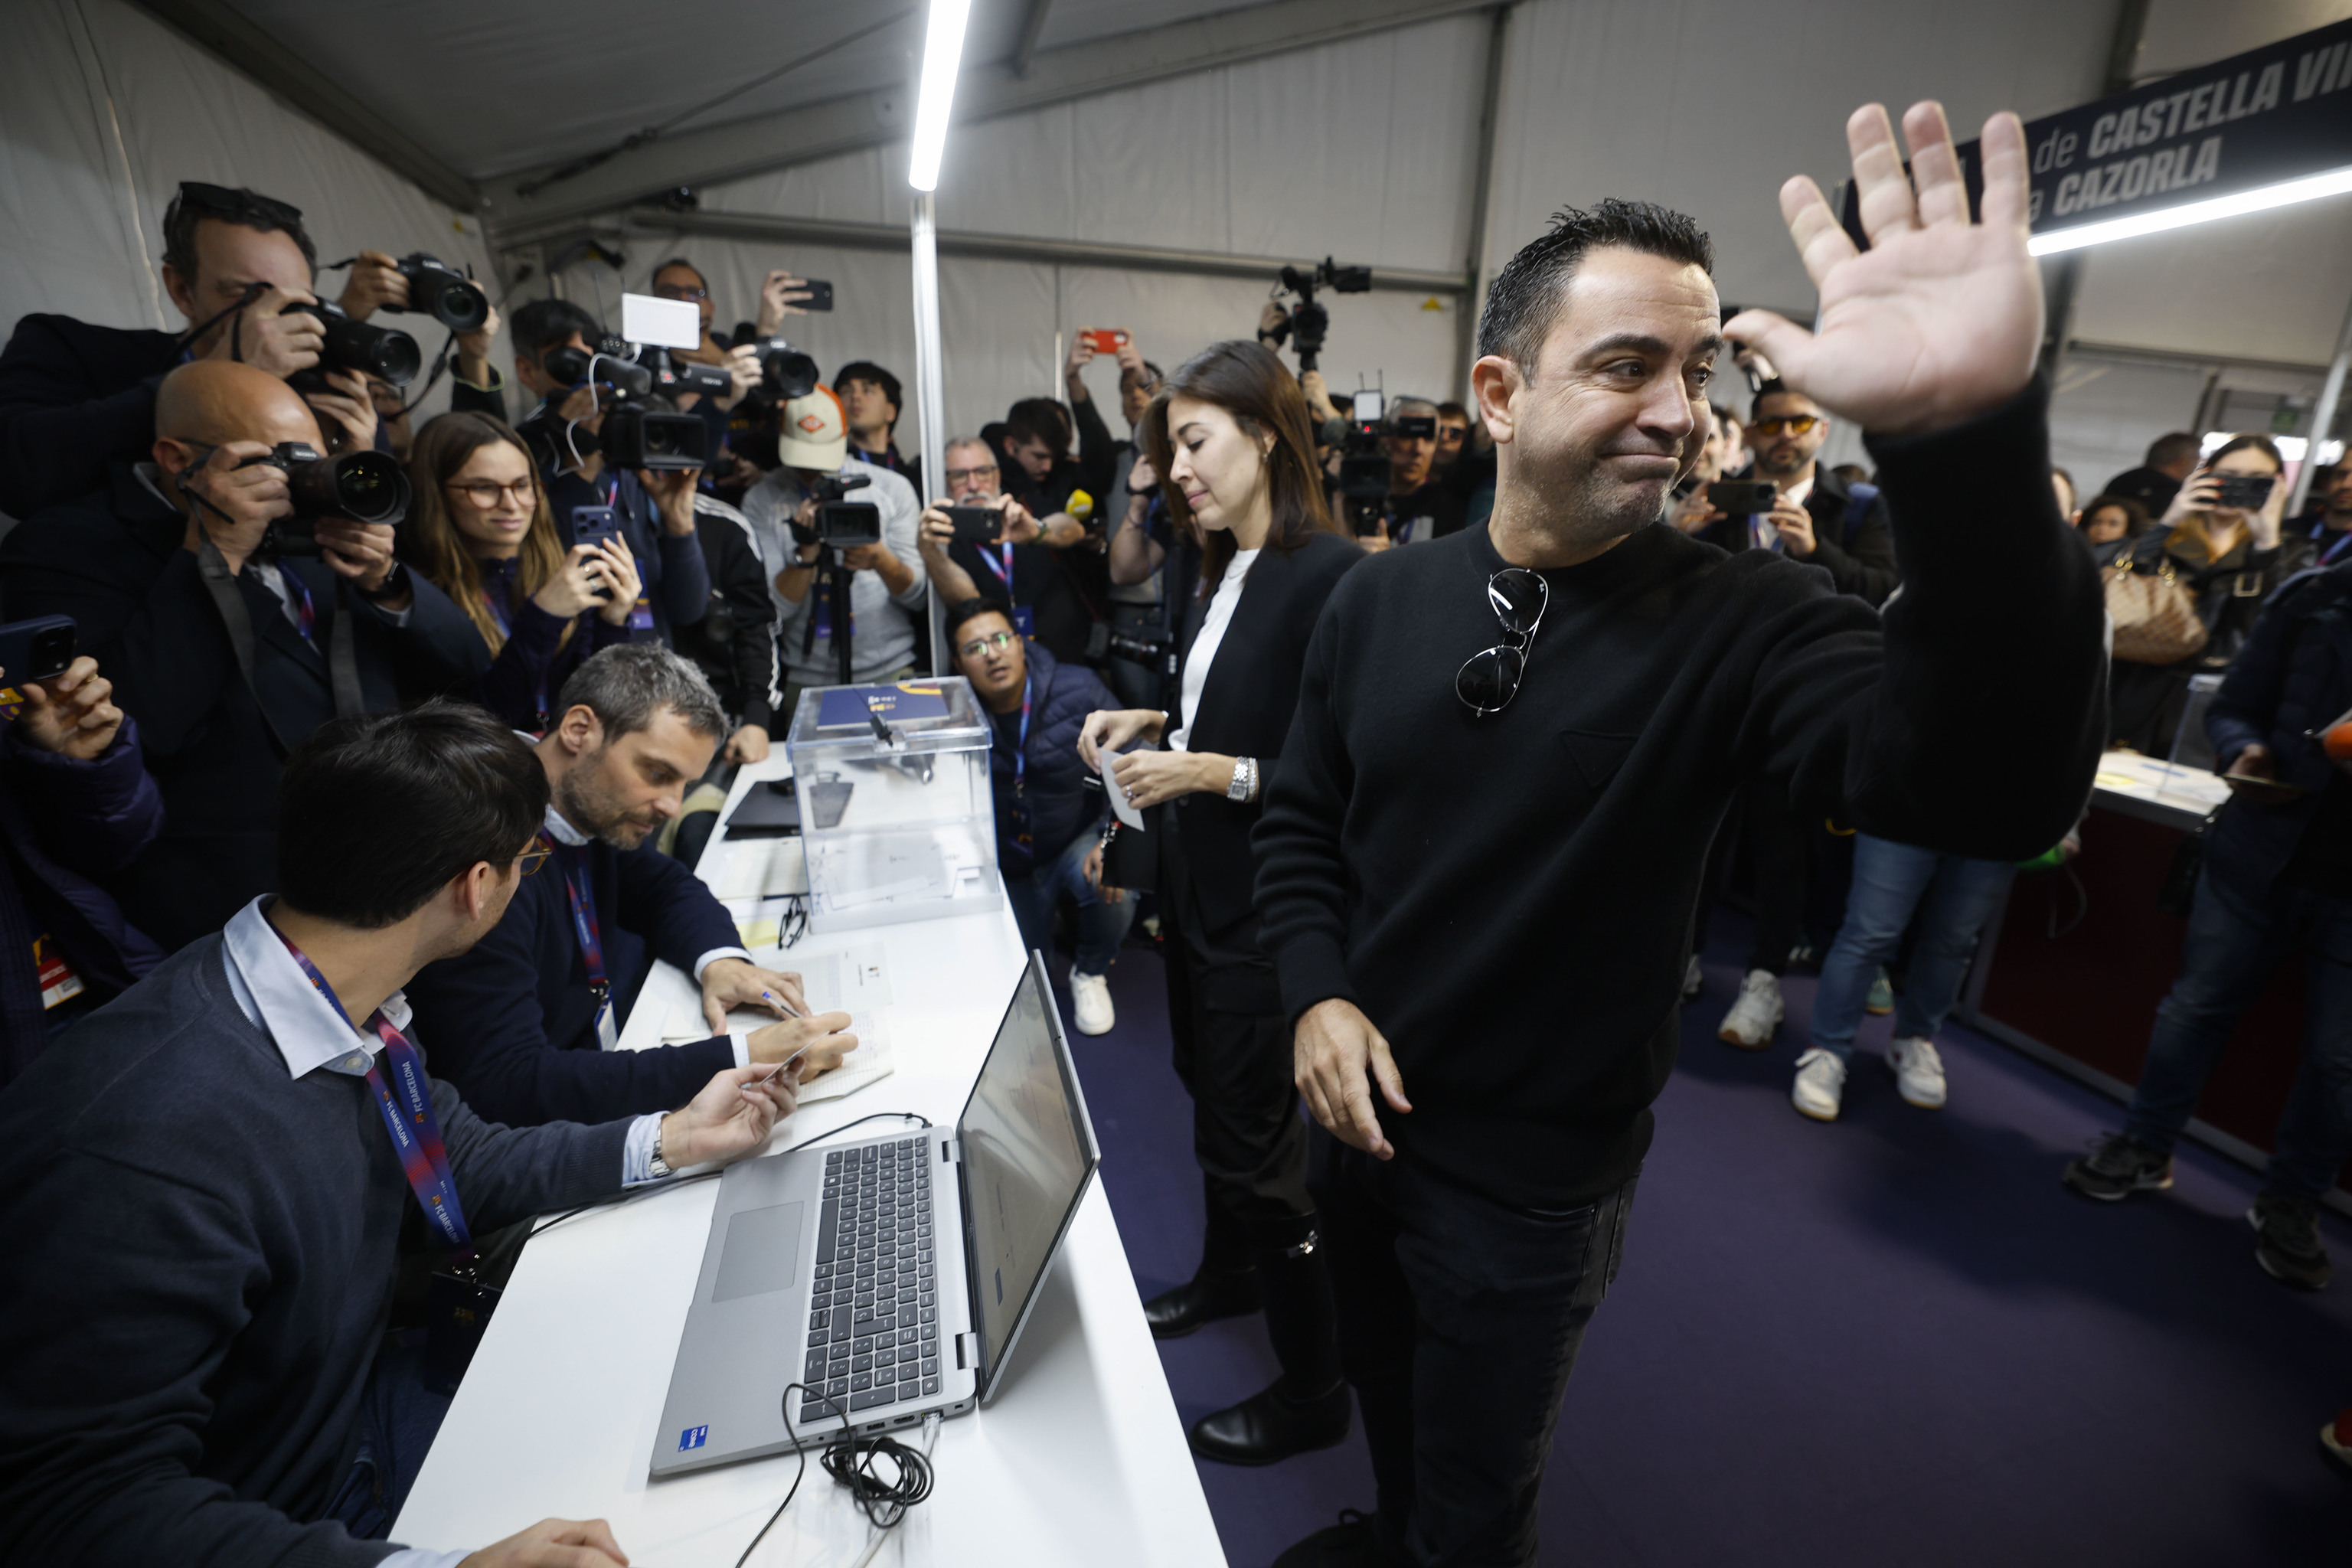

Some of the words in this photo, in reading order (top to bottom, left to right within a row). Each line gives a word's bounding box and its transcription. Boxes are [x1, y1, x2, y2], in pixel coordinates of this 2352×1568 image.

[2033, 126, 2079, 175] de
[2086, 60, 2285, 160] CASTELLA
[2052, 135, 2223, 217] CAZORLA
[402, 1060, 421, 1104] BARCELONA
[387, 1100, 394, 1112] FC
[413, 1102, 423, 1112] FC
[389, 1109, 410, 1148] BARCELONA
[435, 1204, 445, 1215] FC
